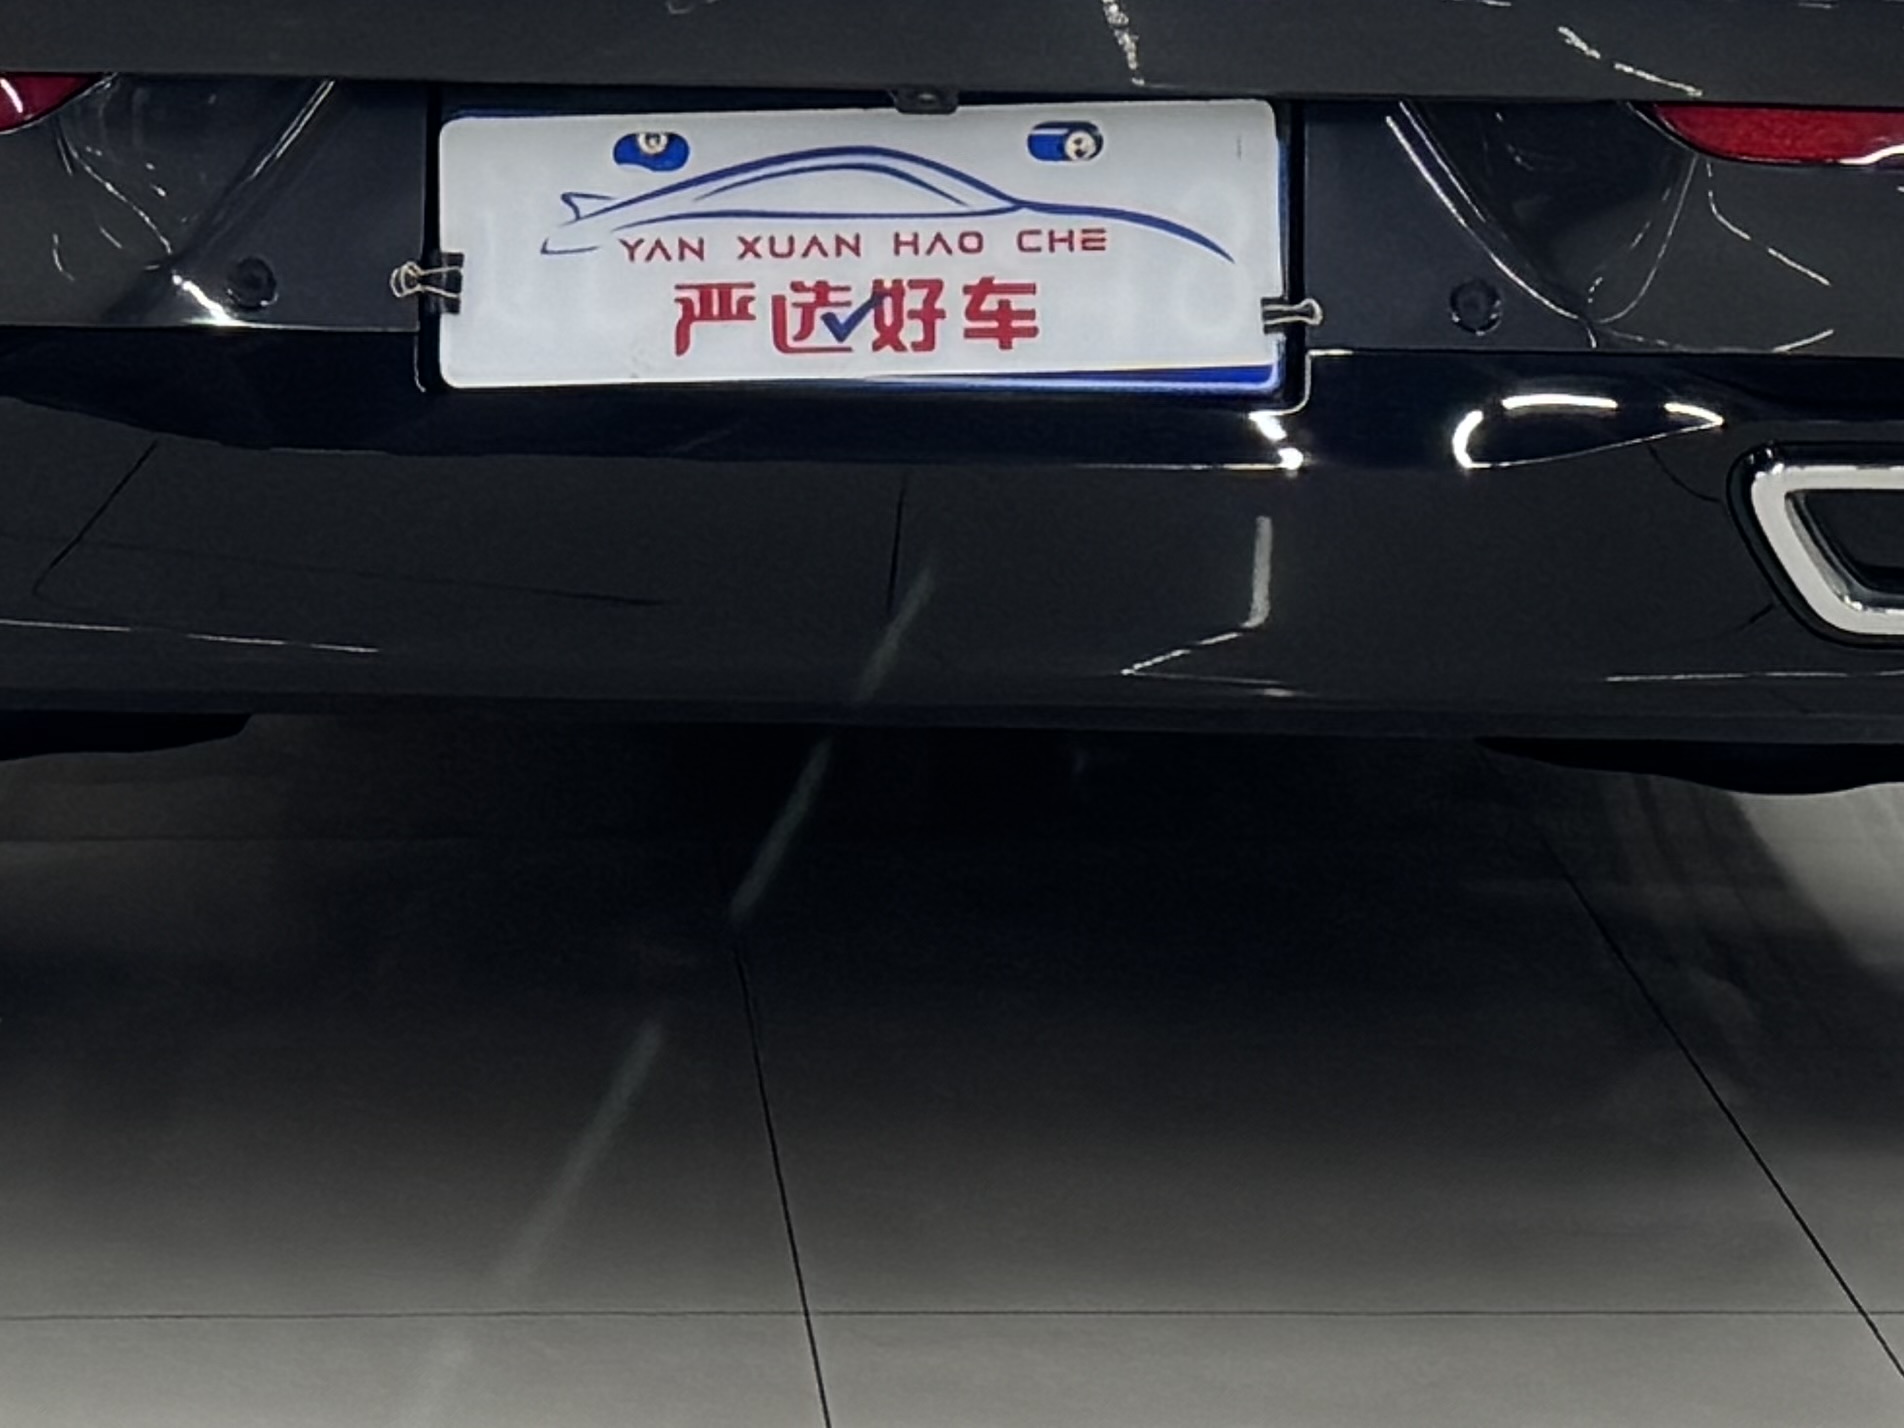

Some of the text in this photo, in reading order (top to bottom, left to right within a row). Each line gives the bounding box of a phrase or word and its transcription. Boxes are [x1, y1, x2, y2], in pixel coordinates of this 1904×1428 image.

[619, 227, 1108, 263] YAN XUAN HAO CHE
[673, 275, 1040, 356] 严选好车
